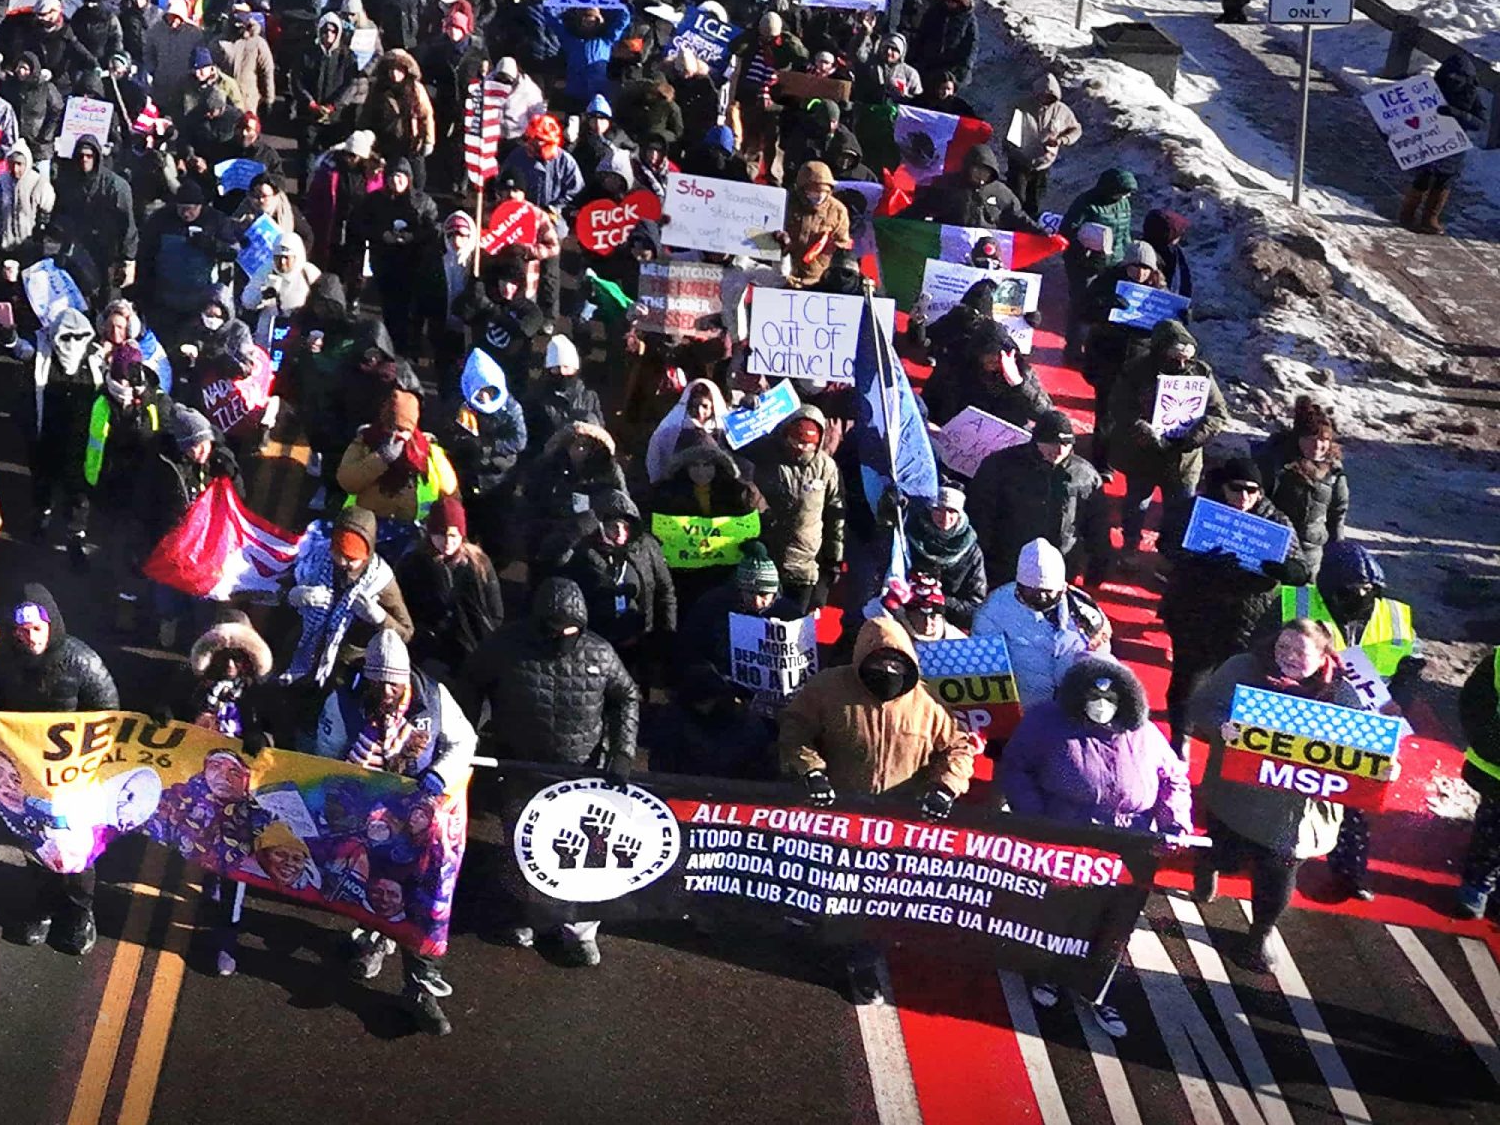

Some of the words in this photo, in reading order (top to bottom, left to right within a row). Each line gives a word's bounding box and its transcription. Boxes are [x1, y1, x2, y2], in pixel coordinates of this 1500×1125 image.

[1287, 7, 1332, 19] ONLY
[1379, 86, 1410, 108] ICE
[675, 178, 716, 205] Stop
[591, 203, 640, 228] FUCK
[781, 293, 847, 327] ICE
[1163, 379, 1179, 391] WE
[1183, 379, 1205, 392] ARE
[682, 524, 721, 538] VIVA
[757, 638, 795, 657] MORE
[764, 621, 787, 643] NO
[736, 662, 762, 687] NO
[939, 674, 1013, 704] OUT
[43, 716, 189, 761] SEIU
[45, 747, 127, 787] LOCAL
[137, 749, 173, 768] 26
[1303, 739, 1390, 777] OUT
[1258, 759, 1349, 797] MSP
[521, 809, 560, 889] WORKERS
[544, 780, 669, 821] SOLIDARITY
[627, 826, 673, 885] CIRCLE
[691, 803, 742, 825] ALL
[749, 808, 851, 839] POWER
[859, 817, 894, 846] TO
[902, 823, 959, 853] THE
[965, 832, 1124, 887] WORKERS!
[686, 852, 774, 877] AWOODDA
[778, 861, 804, 882] OO
[807, 867, 860, 893] DHAN
[862, 875, 993, 909] SHAQAALAHA!
[689, 829, 742, 849] ¡TODO
[746, 832, 769, 852] EL
[773, 835, 834, 866] PODER
[837, 848, 851, 868] A
[854, 849, 891, 873] LOS
[894, 853, 1048, 900] TRABAJADORES!
[684, 875, 741, 895] TXHUA
[746, 879, 782, 903] LUB
[785, 886, 822, 913] ZOG
[825, 896, 862, 915] RAU
[864, 900, 903, 918] COV
[904, 902, 953, 924] NEEG
[957, 911, 983, 932] UA
[986, 915, 1091, 959] HAUJLWM!
